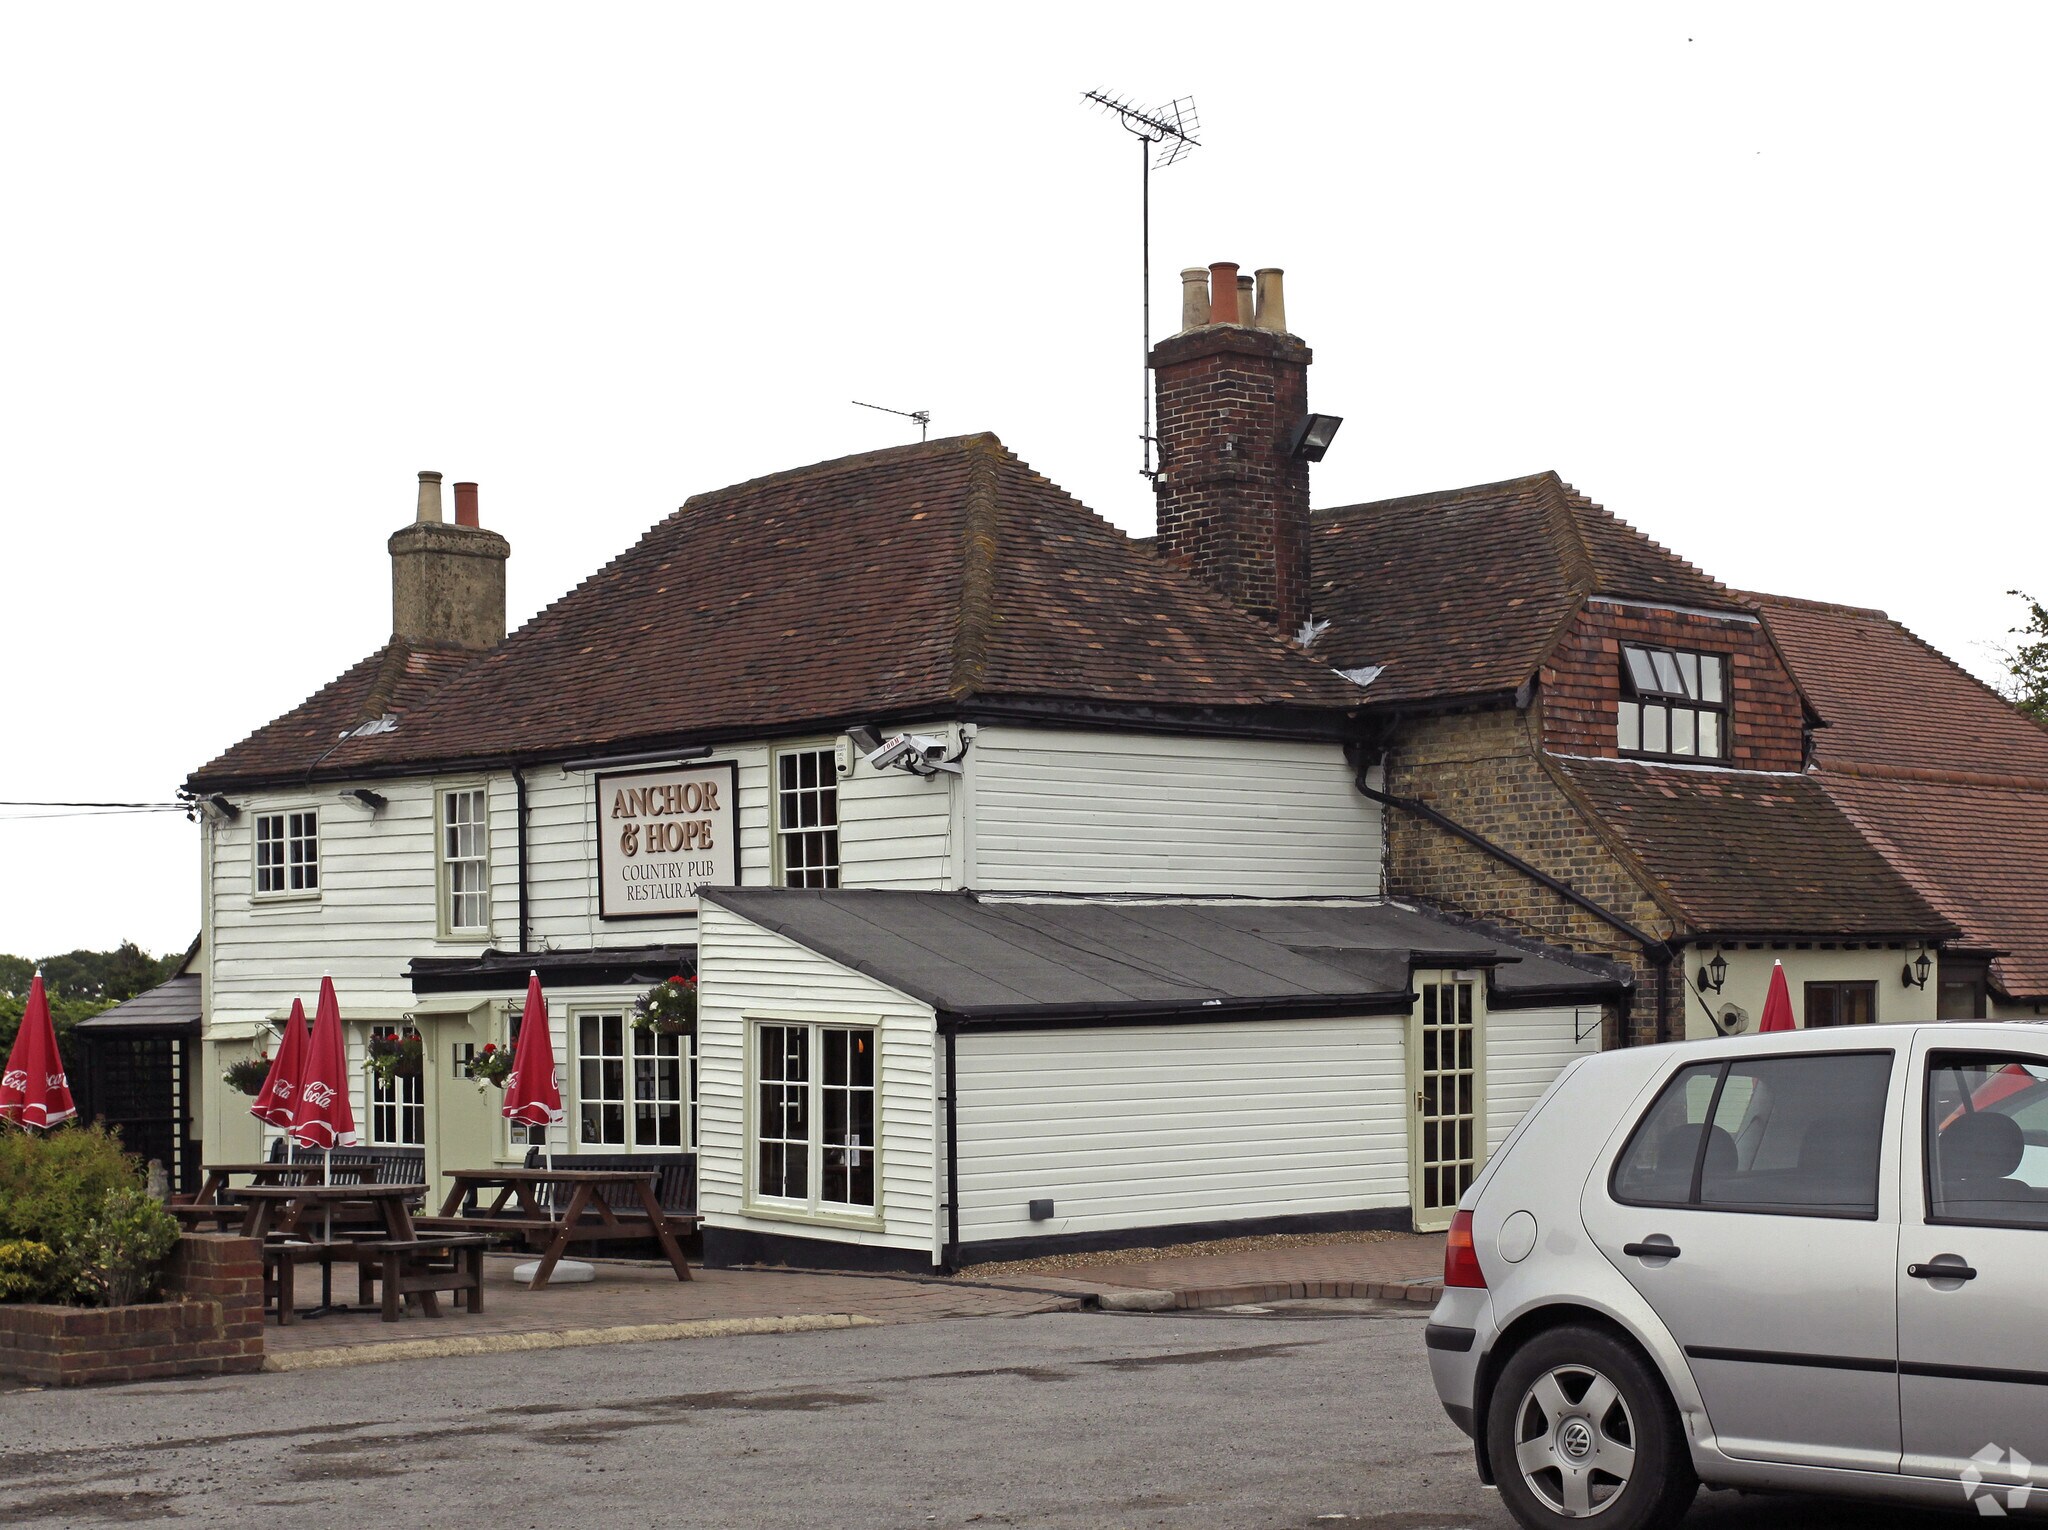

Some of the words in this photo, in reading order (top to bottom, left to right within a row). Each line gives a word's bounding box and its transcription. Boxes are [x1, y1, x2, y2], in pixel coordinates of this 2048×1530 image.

[611, 781, 721, 818] ANCHOR
[620, 823, 640, 857] &
[644, 819, 714, 853] HOPE
[622, 862, 684, 881] COUNTRY
[688, 860, 714, 877] PUB
[303, 1081, 337, 1108] Cola
